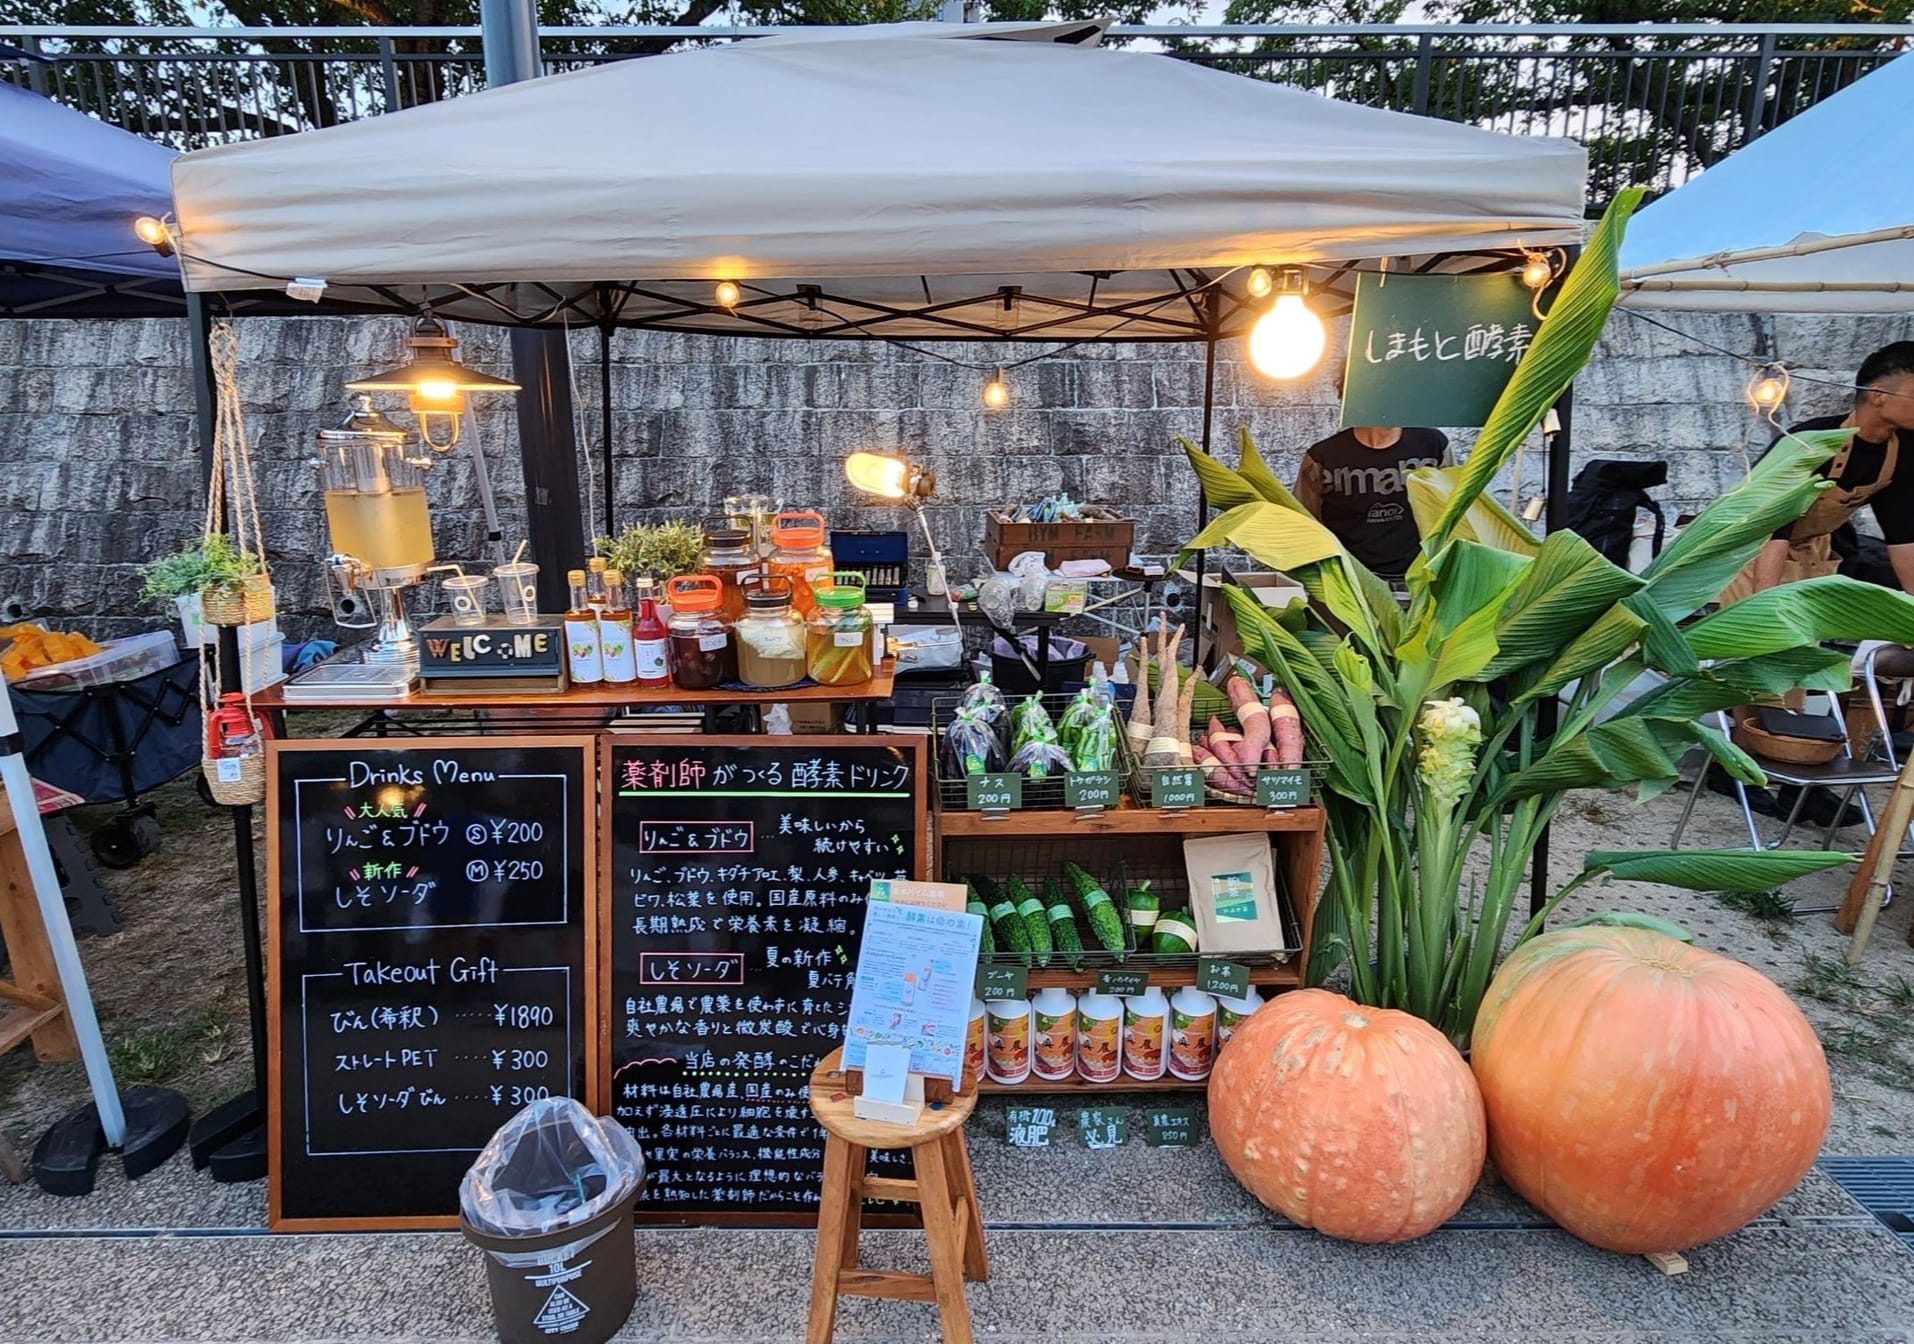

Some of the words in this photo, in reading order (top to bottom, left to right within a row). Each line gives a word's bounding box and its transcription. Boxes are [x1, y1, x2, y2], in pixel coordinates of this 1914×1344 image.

[1365, 322, 1533, 364] しまもと酵素
[425, 634, 548, 662] WELCOME
[350, 761, 424, 788] Drinks
[433, 759, 496, 784] Menu
[980, 777, 1005, 788] ナス
[1070, 775, 1112, 787] トウガラシ
[1261, 774, 1303, 785] サツマイモ
[978, 793, 1011, 805] 200円
[1079, 789, 1109, 801] 200円
[1269, 791, 1297, 801] 300円
[358, 802, 409, 818] 大人気
[778, 813, 866, 834] 美味しいから
[813, 838, 889, 855] 続けやすい
[363, 861, 402, 881] 新作
[336, 881, 436, 908] しそソーダ
[634, 889, 871, 909] ビワ、松葉を使用。国産原料のみ
[766, 946, 832, 968] 夏の新作
[343, 958, 441, 985] Takeout
[450, 957, 499, 983] Gift
[650, 958, 740, 980] しそソーダ
[984, 986, 1015, 997] 200円
[493, 1003, 553, 1029] ¥1890
[616, 1103, 815, 1120] 加えず浸透圧により細胞を壊す
[1009, 1123, 1049, 1145] 液肥
[1085, 1125, 1123, 1145] 必見
[549, 1262, 566, 1273] 10L
